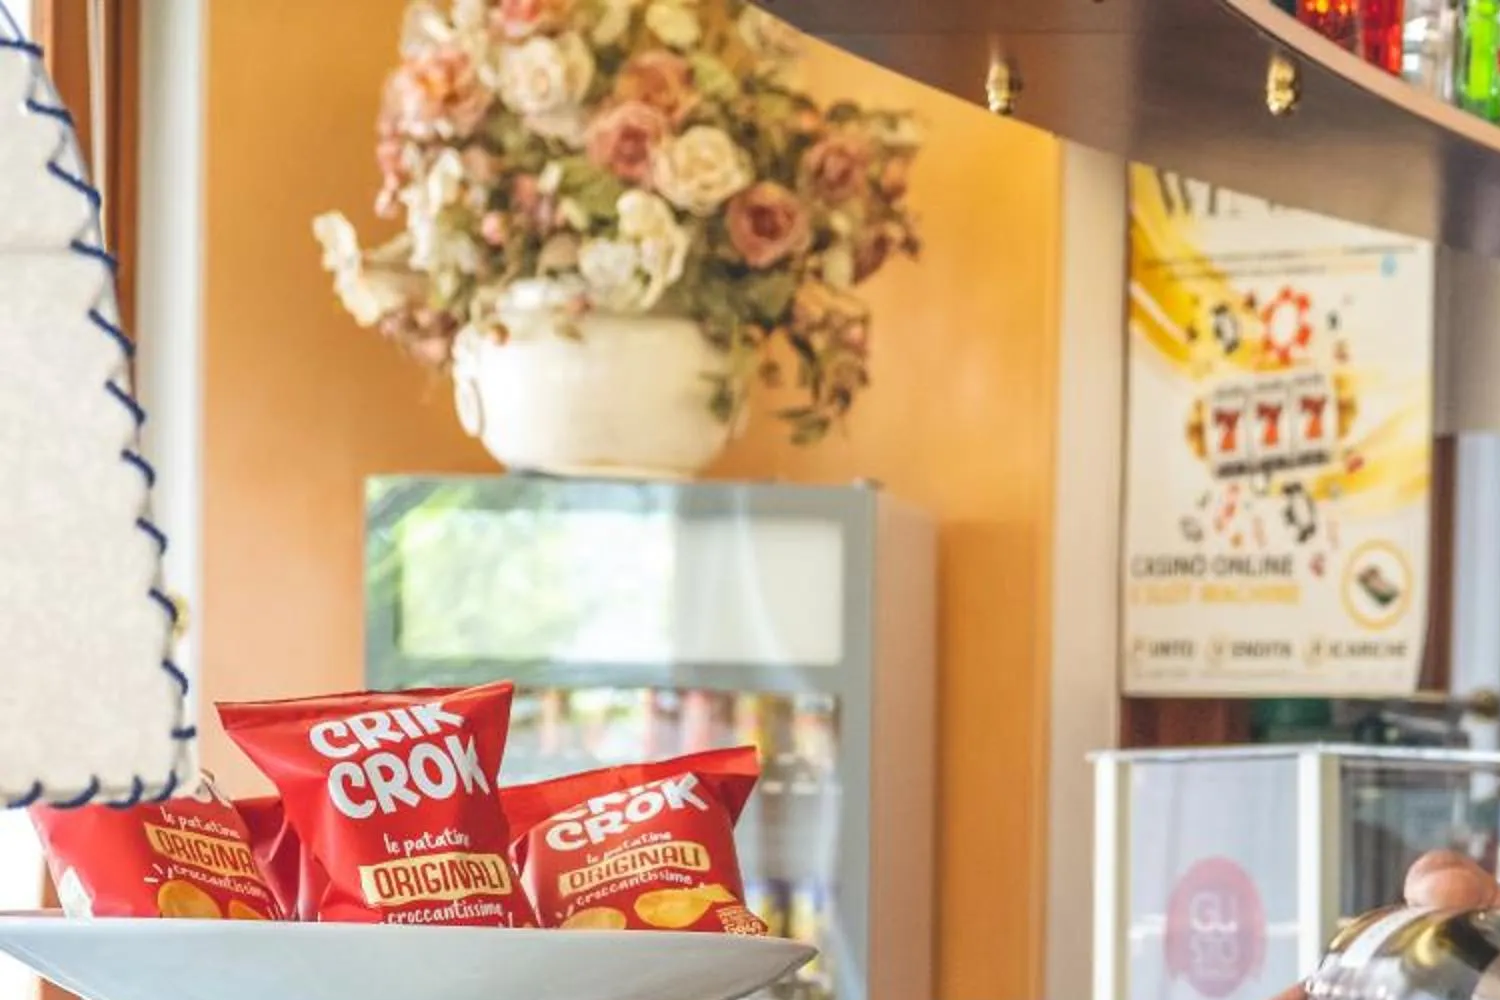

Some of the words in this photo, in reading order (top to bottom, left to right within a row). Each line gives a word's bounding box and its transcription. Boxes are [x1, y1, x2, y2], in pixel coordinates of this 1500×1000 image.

[1131, 554, 1206, 578] CASINO
[1212, 552, 1293, 577] ONLINE
[310, 702, 464, 758] CRIK
[328, 735, 491, 819] CROK
[545, 771, 709, 851] CROK
[155, 829, 258, 877] ORIGINA
[384, 833, 400, 853] le
[404, 827, 470, 857] patatin
[373, 859, 505, 898] ORIGINALI
[569, 846, 702, 889] ORIGINALI
[576, 868, 693, 906] croccantissime
